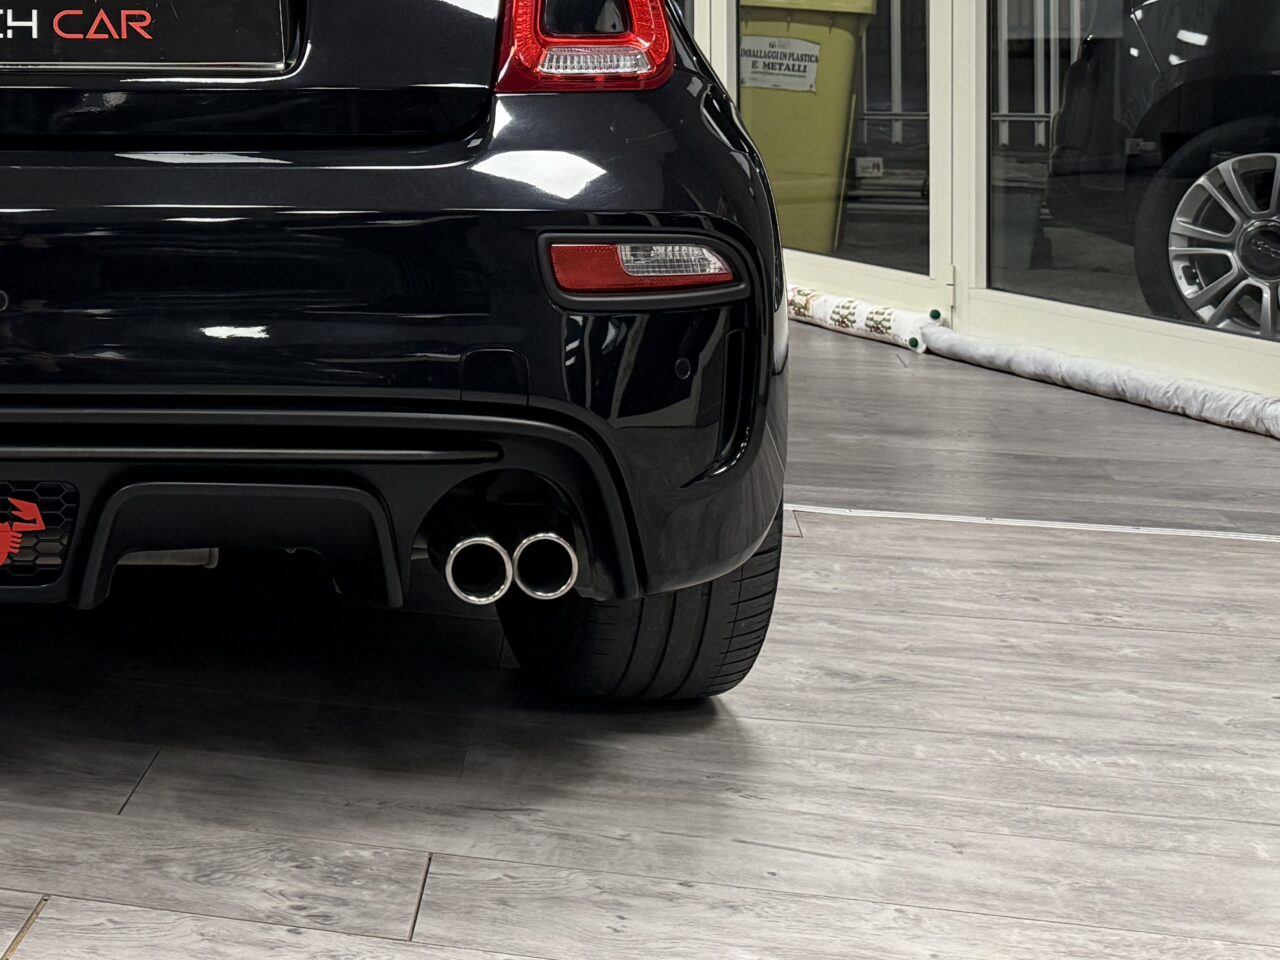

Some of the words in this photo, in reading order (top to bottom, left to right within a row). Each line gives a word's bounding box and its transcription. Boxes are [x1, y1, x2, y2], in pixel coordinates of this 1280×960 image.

[52, 7, 153, 40] CAR
[788, 52, 819, 63] PLASTICA
[752, 61, 758, 69] E
[762, 61, 808, 73] METALLI
